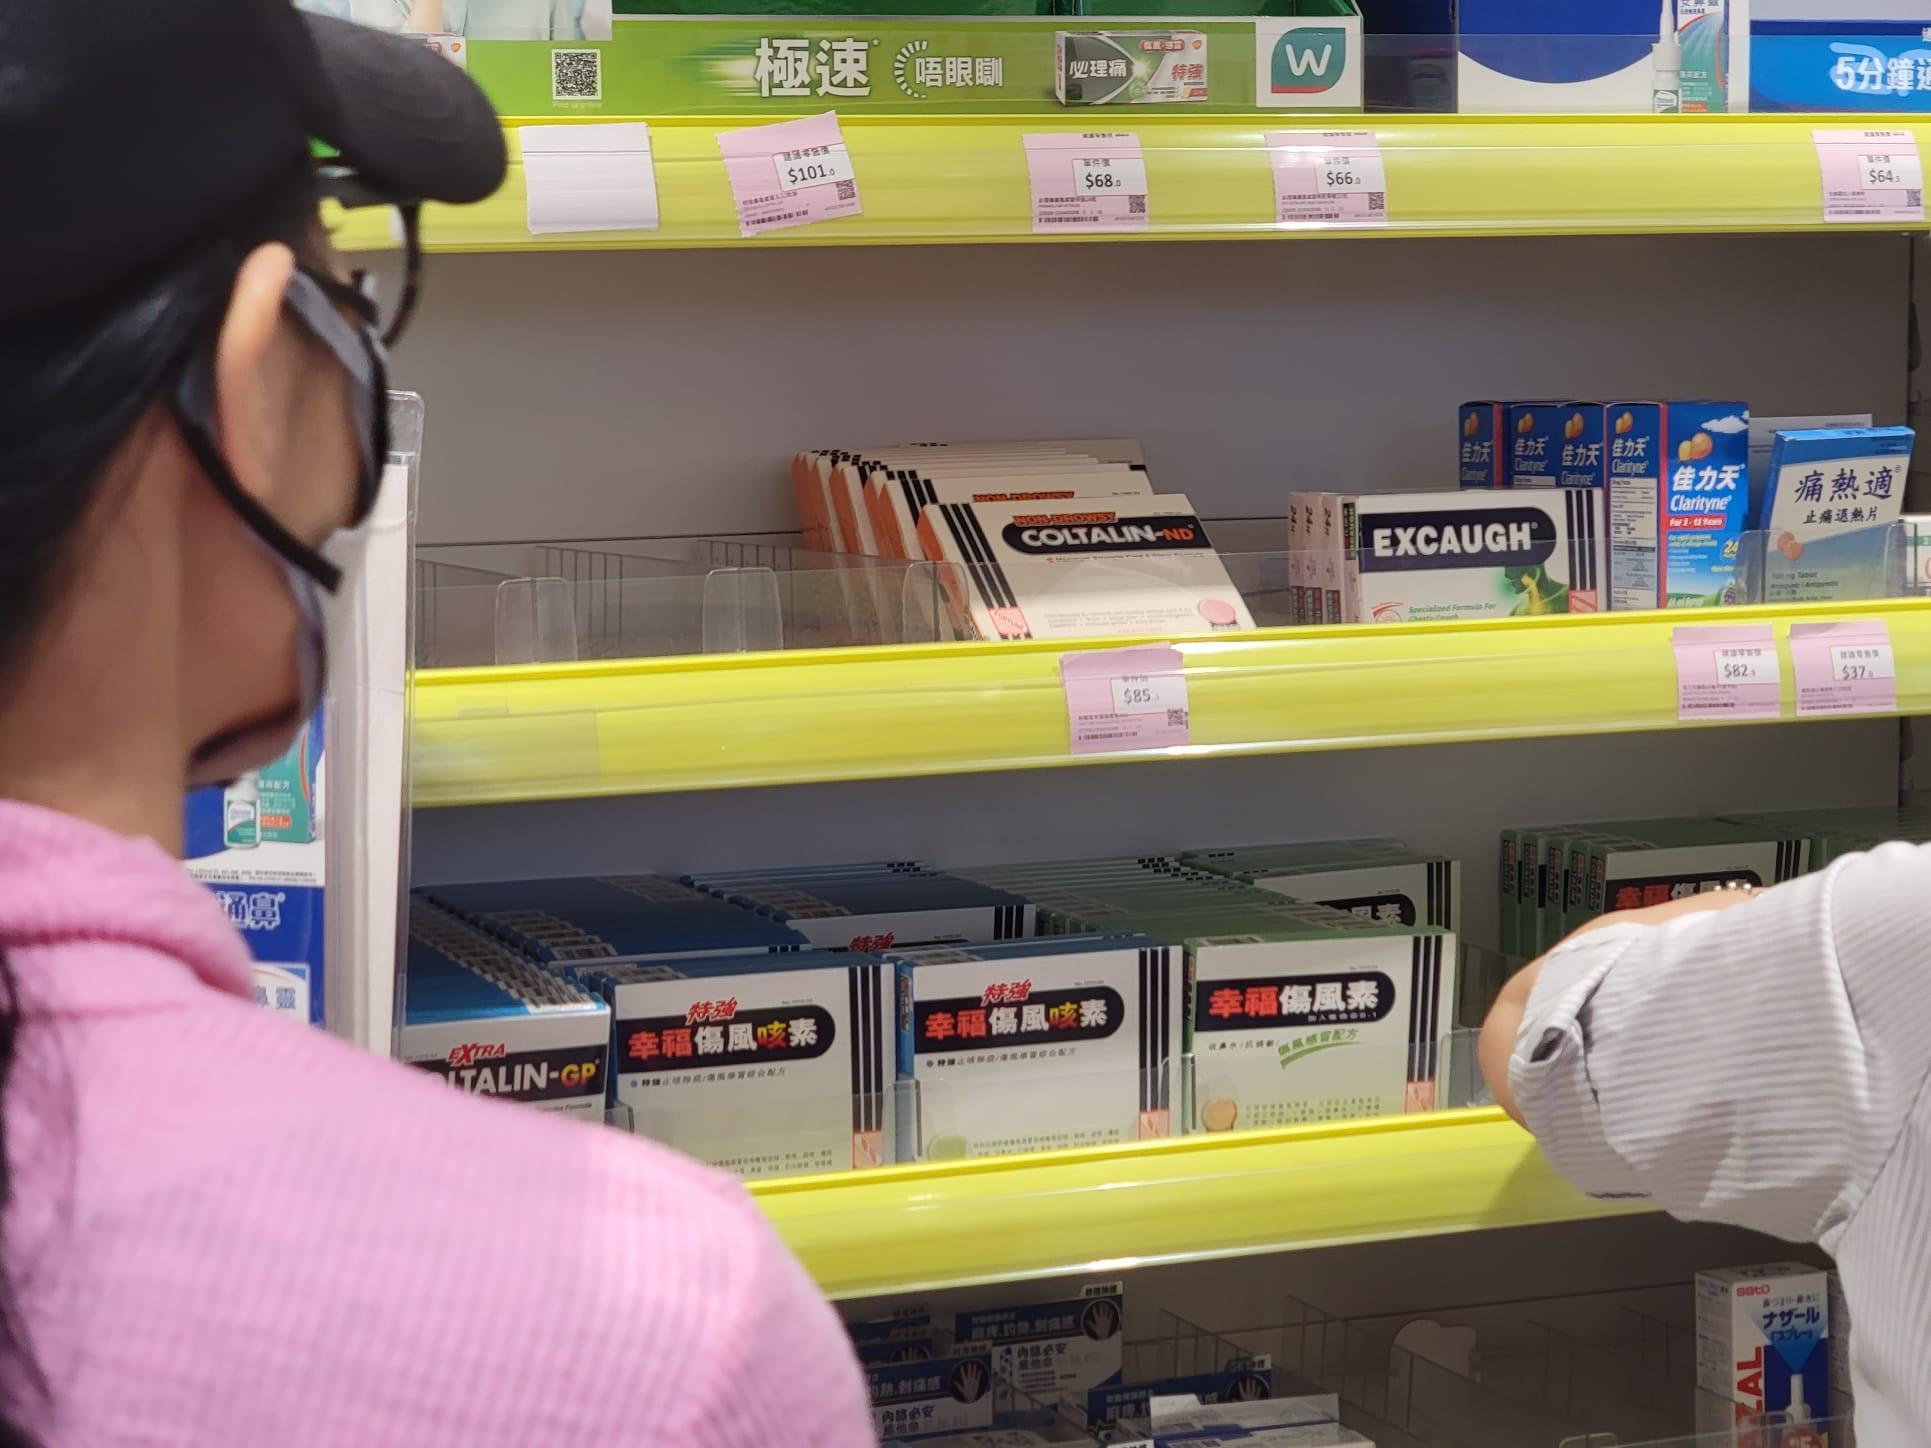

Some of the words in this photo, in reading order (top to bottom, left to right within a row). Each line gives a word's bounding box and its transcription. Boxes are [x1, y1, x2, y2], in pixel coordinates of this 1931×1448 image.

[755, 37, 871, 97] 極速
[915, 57, 1003, 87] 唔眼瞓
[1069, 59, 1127, 79] 必理痛
[1171, 63, 1204, 81] 特強
[1285, 44, 1332, 76] W
[788, 164, 835, 185] $101.0
[1461, 441, 1491, 463] 佳力天
[1514, 438, 1546, 456] 佳力天
[1561, 443, 1600, 467] 佳力天
[1612, 438, 1647, 457] 佳力天
[1672, 464, 1738, 492] 佳力天
[1794, 465, 1893, 504] 痛熱適
[1670, 494, 1727, 514] Clarityne
[1012, 511, 1117, 527] NON-DROWSY
[1021, 524, 1195, 547] COLTALIN-ND
[1373, 522, 1533, 557] EXCAUGH
[1123, 688, 1160, 705] $85.
[980, 978, 1033, 1006] 特強
[1208, 980, 1379, 1019] 幸福傷風素
[686, 997, 737, 1024] 特強
[924, 998, 1108, 1042] 幸福傷風咳素
[627, 1017, 818, 1060] 幸福傷風咳素
[448, 1043, 506, 1067] EXTRA
[430, 1061, 597, 1097] LTALIN-GP
[1763, 1306, 1820, 1329] ナザール
